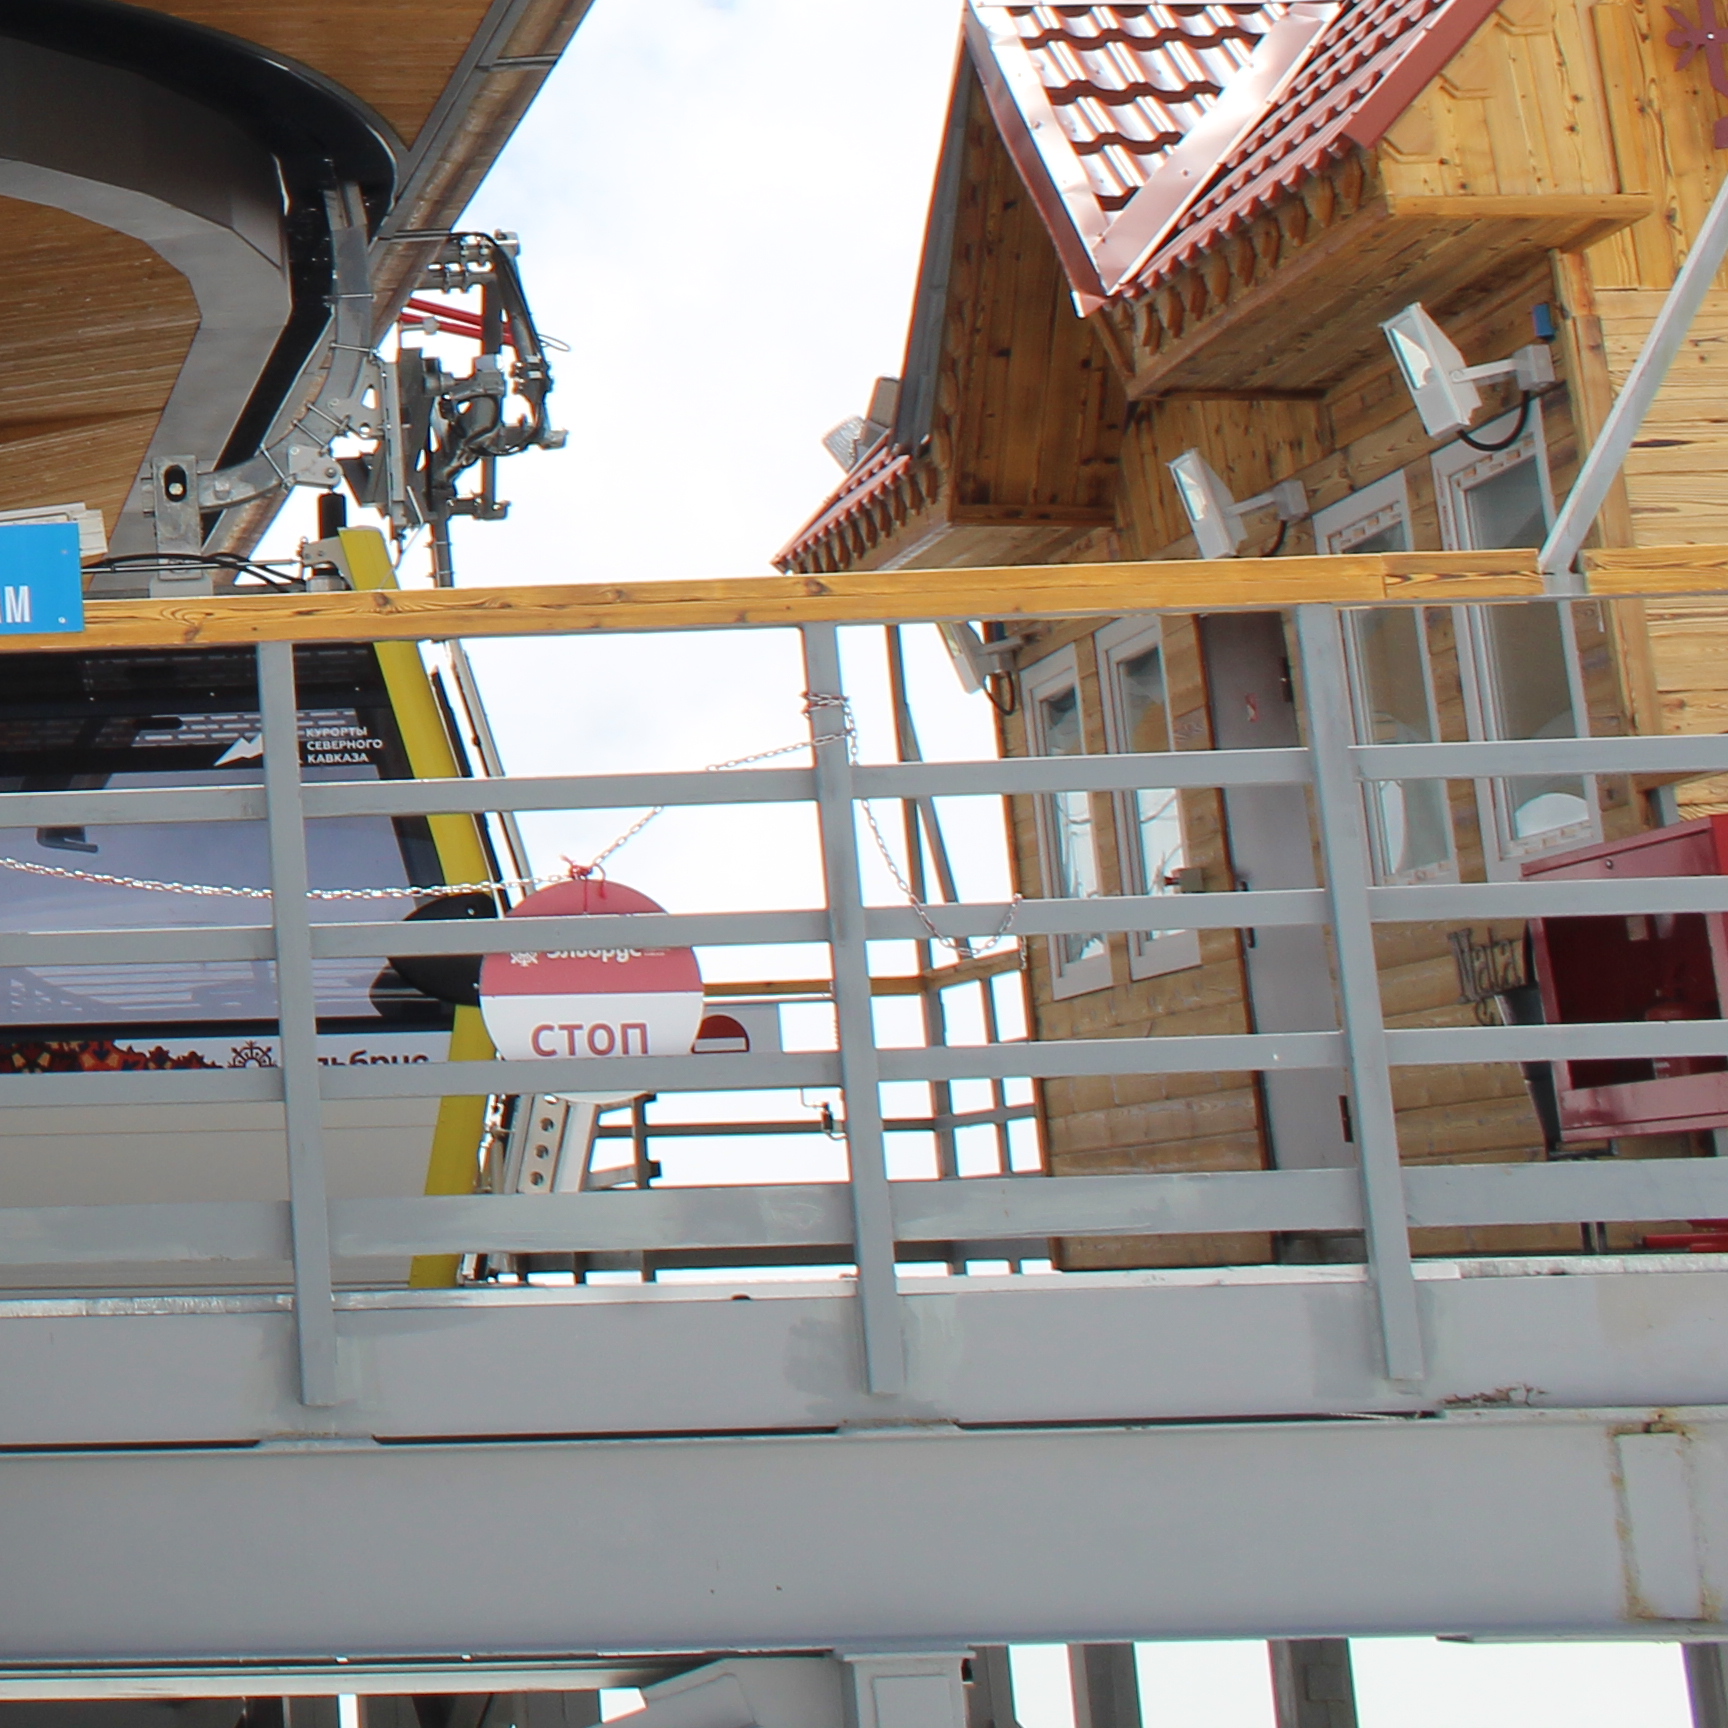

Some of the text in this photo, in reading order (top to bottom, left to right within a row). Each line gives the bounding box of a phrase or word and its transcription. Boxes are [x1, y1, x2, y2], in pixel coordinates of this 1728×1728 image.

[305, 726, 368, 738] КУРОРТЫ
[306, 738, 384, 751] СЕВЕРНОГО
[307, 752, 370, 764] КАВКАЗА
[530, 1021, 650, 1057] СТОП
